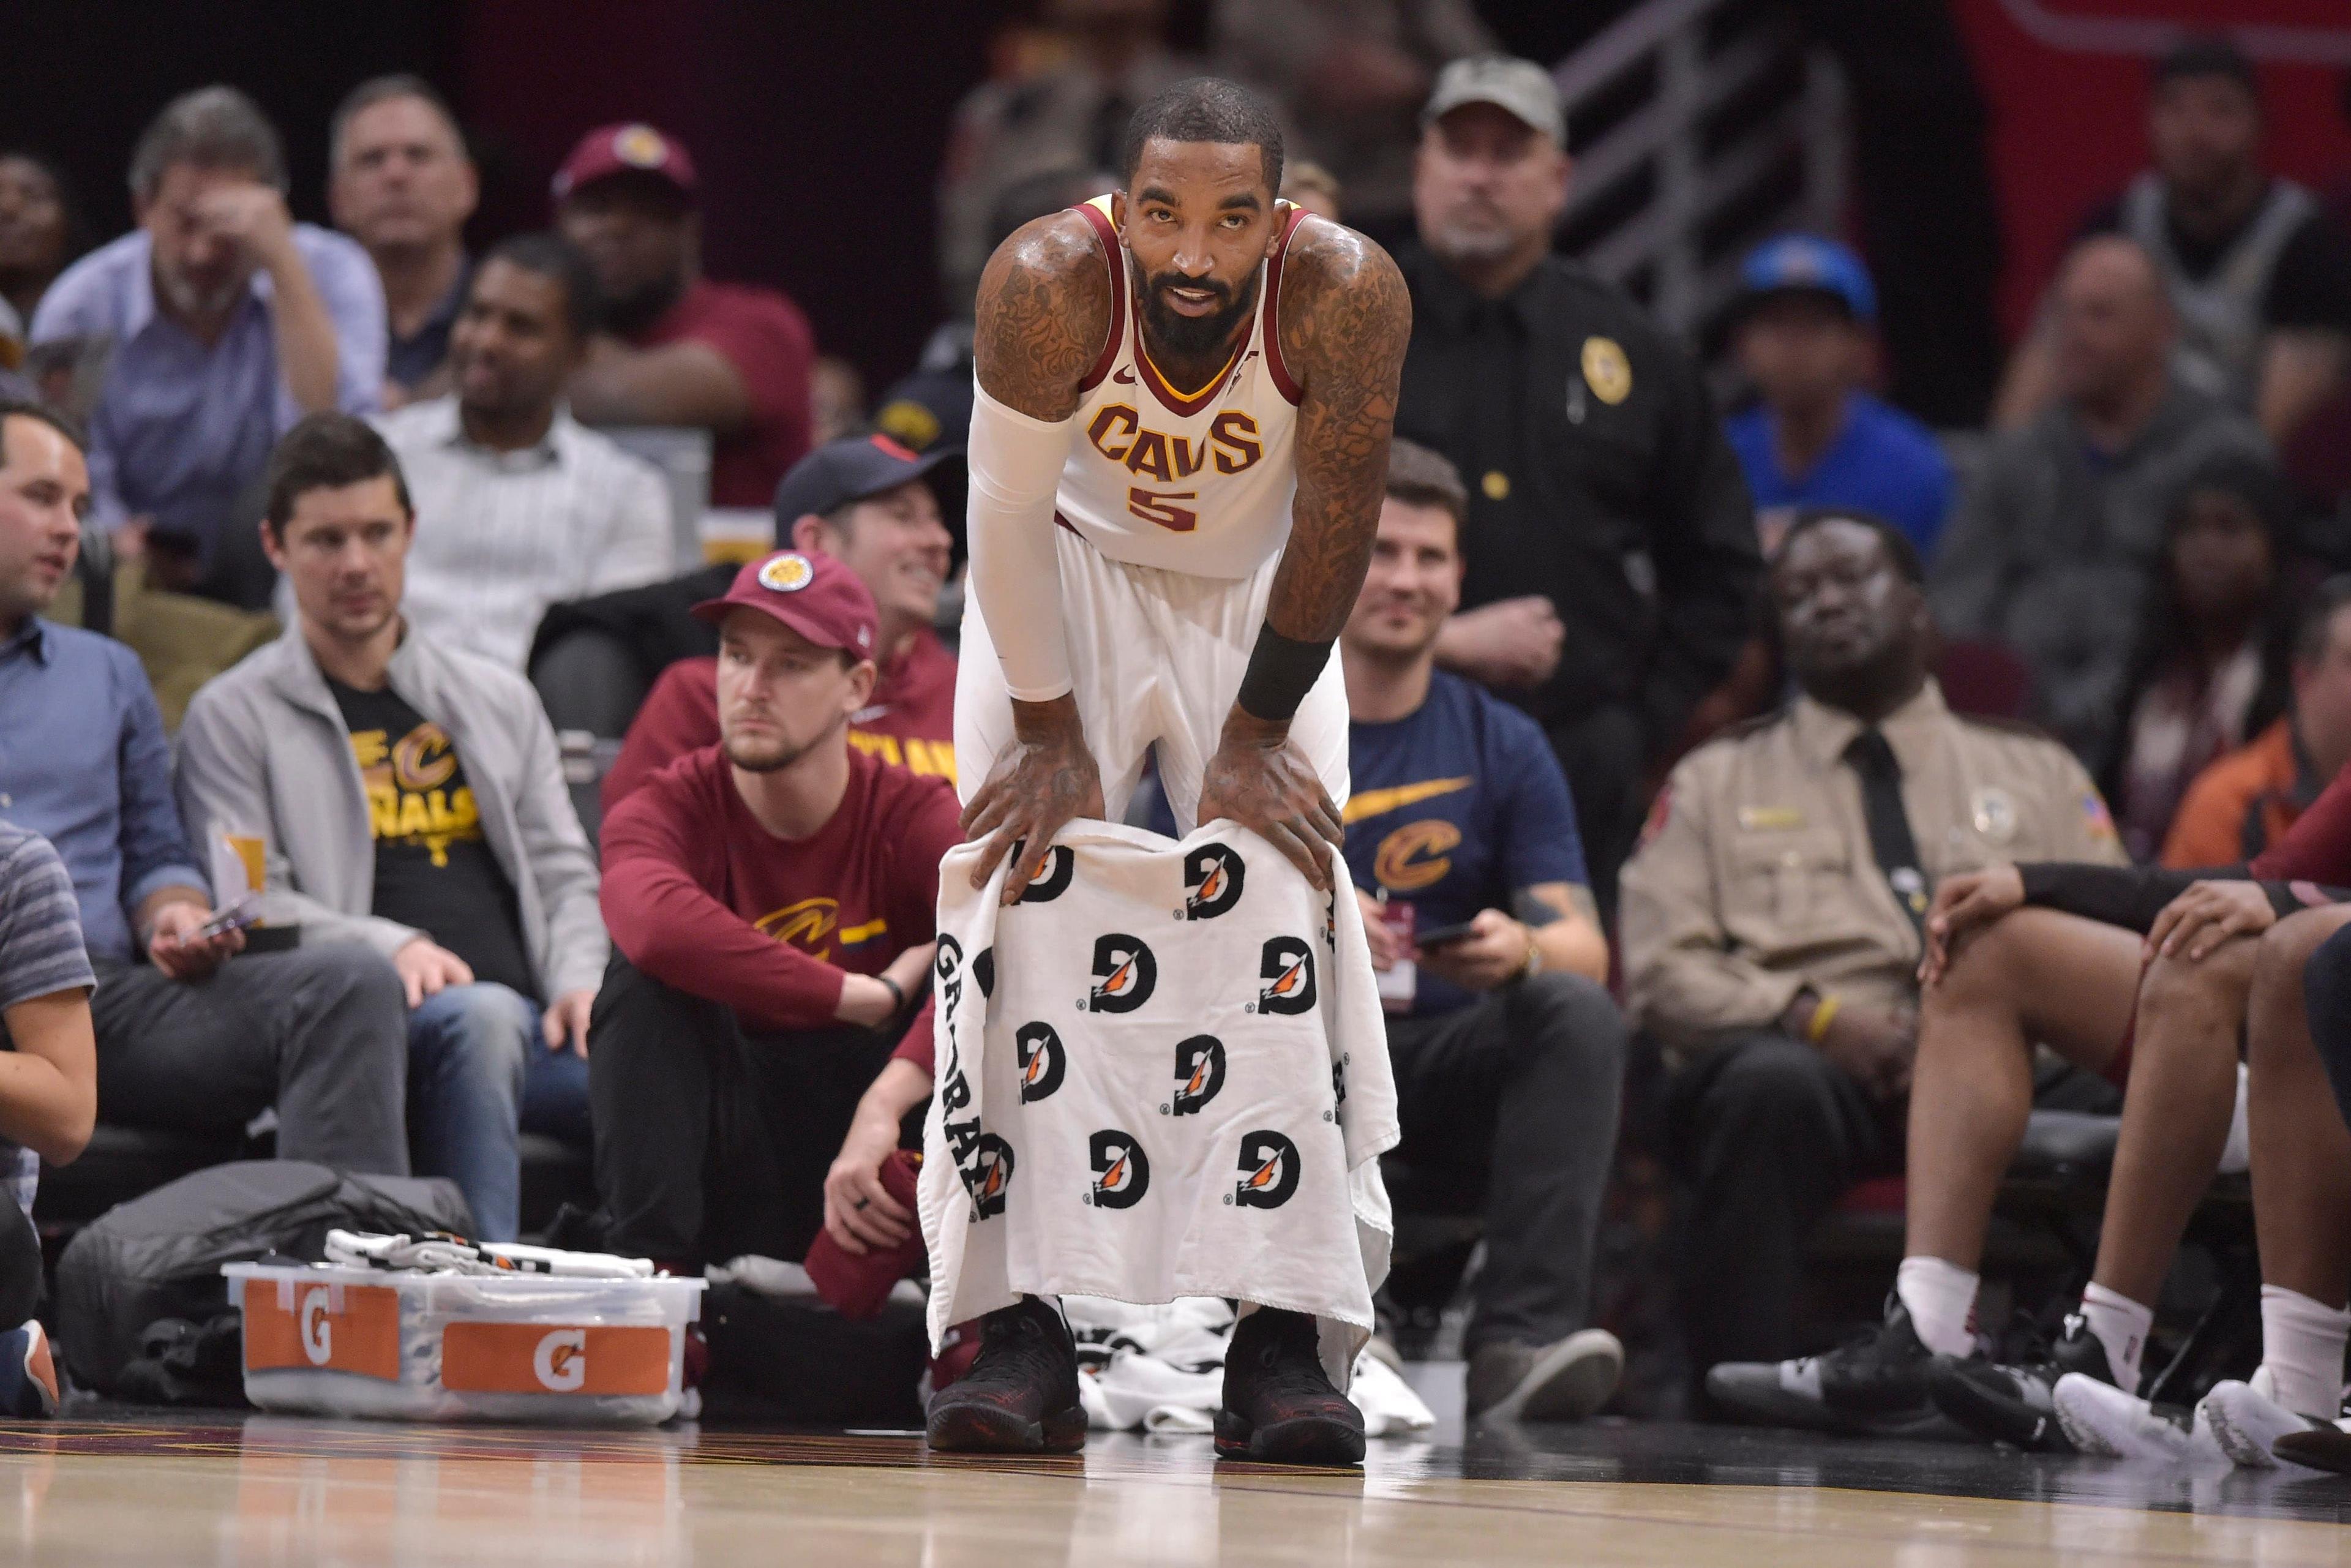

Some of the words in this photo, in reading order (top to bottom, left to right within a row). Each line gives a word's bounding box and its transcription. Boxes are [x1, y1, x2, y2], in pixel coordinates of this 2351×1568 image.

[1087, 402, 1265, 483] CAVS
[1127, 485, 1198, 533] 5
[1185, 842, 1245, 920] G
[1373, 819, 1462, 891] C
[1090, 933, 1157, 1013] G
[1258, 936, 1317, 1015] G
[1089, 1130, 1150, 1209] G
[1236, 1130, 1301, 1210] G
[301, 1287, 332, 1366] G
[533, 1329, 586, 1392] G
